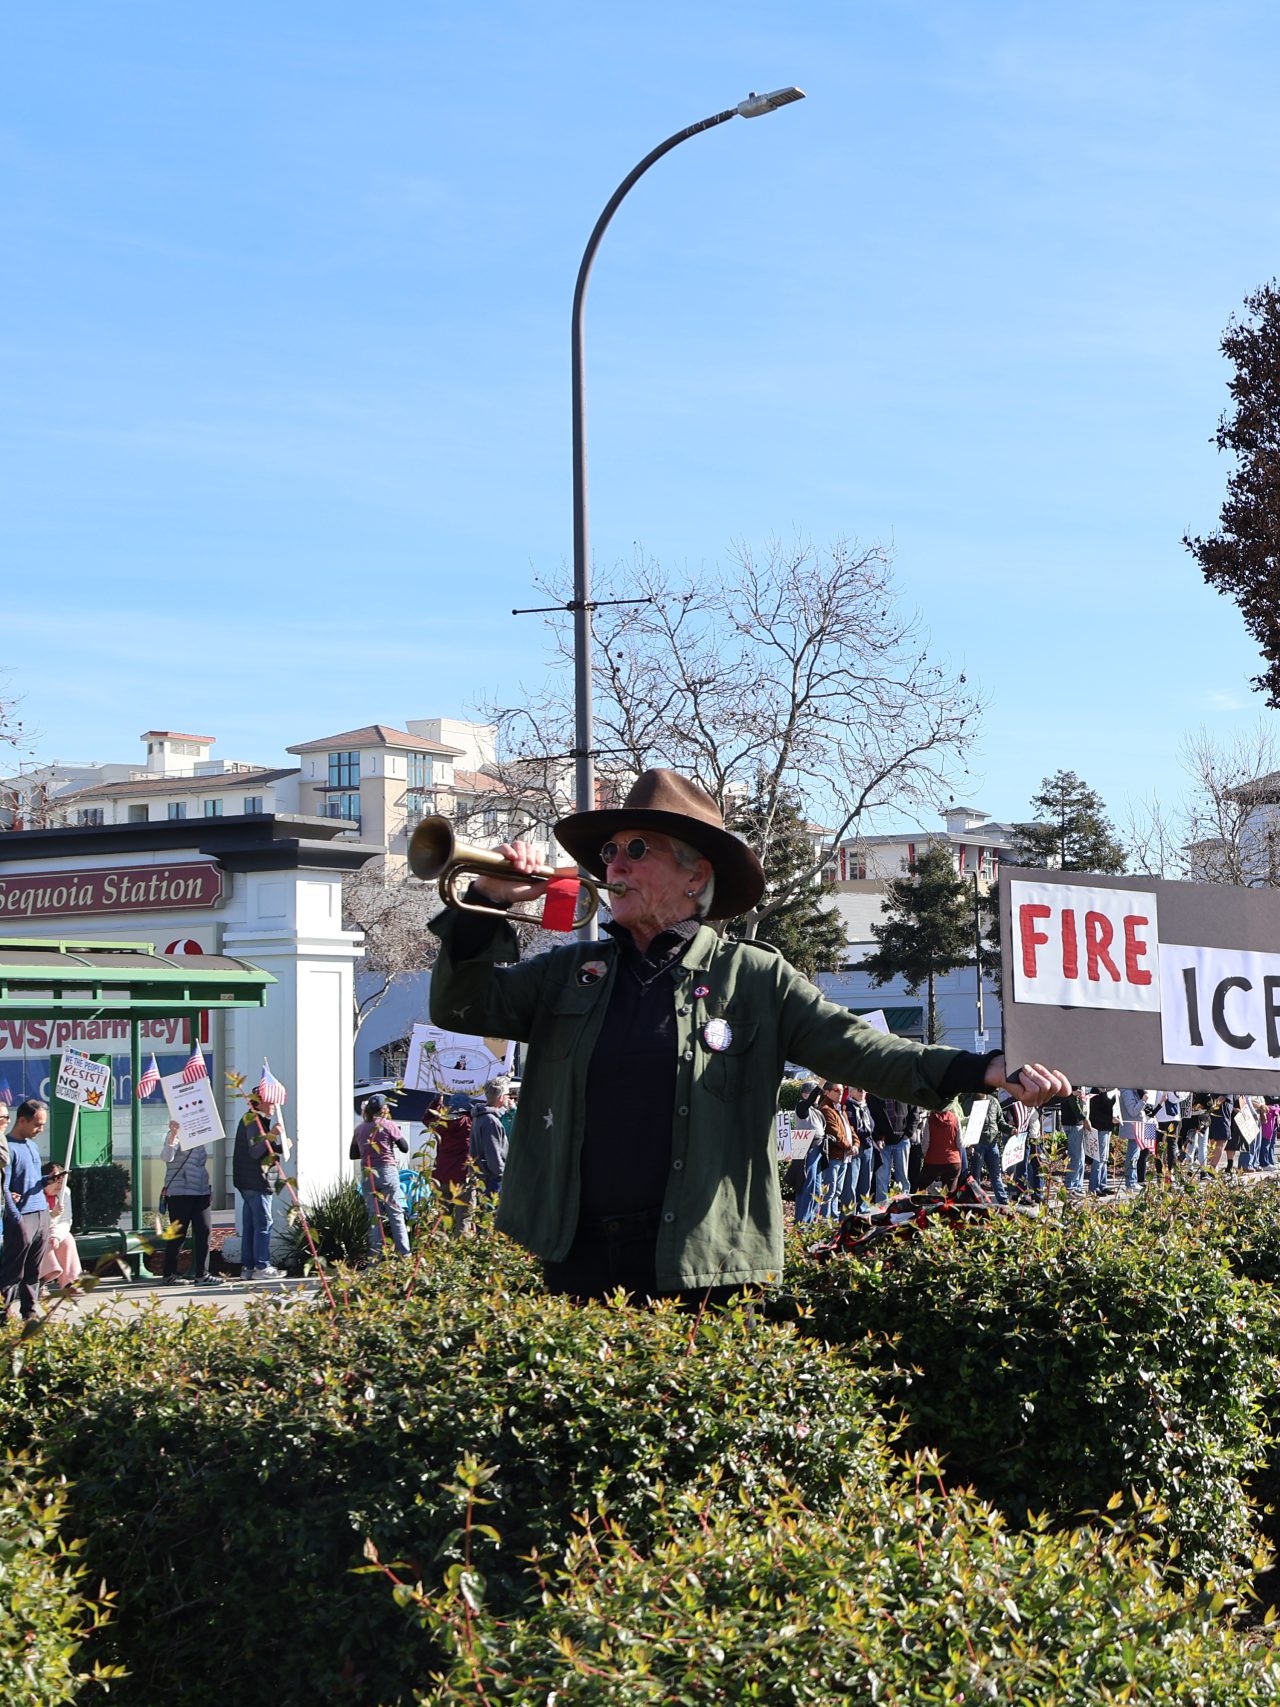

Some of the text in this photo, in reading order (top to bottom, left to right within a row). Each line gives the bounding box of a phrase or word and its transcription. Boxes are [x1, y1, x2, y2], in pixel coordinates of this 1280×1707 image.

[102, 871, 203, 905] Station
[1019, 904, 1152, 986] FIRE
[59, 1075, 79, 1089] NO
